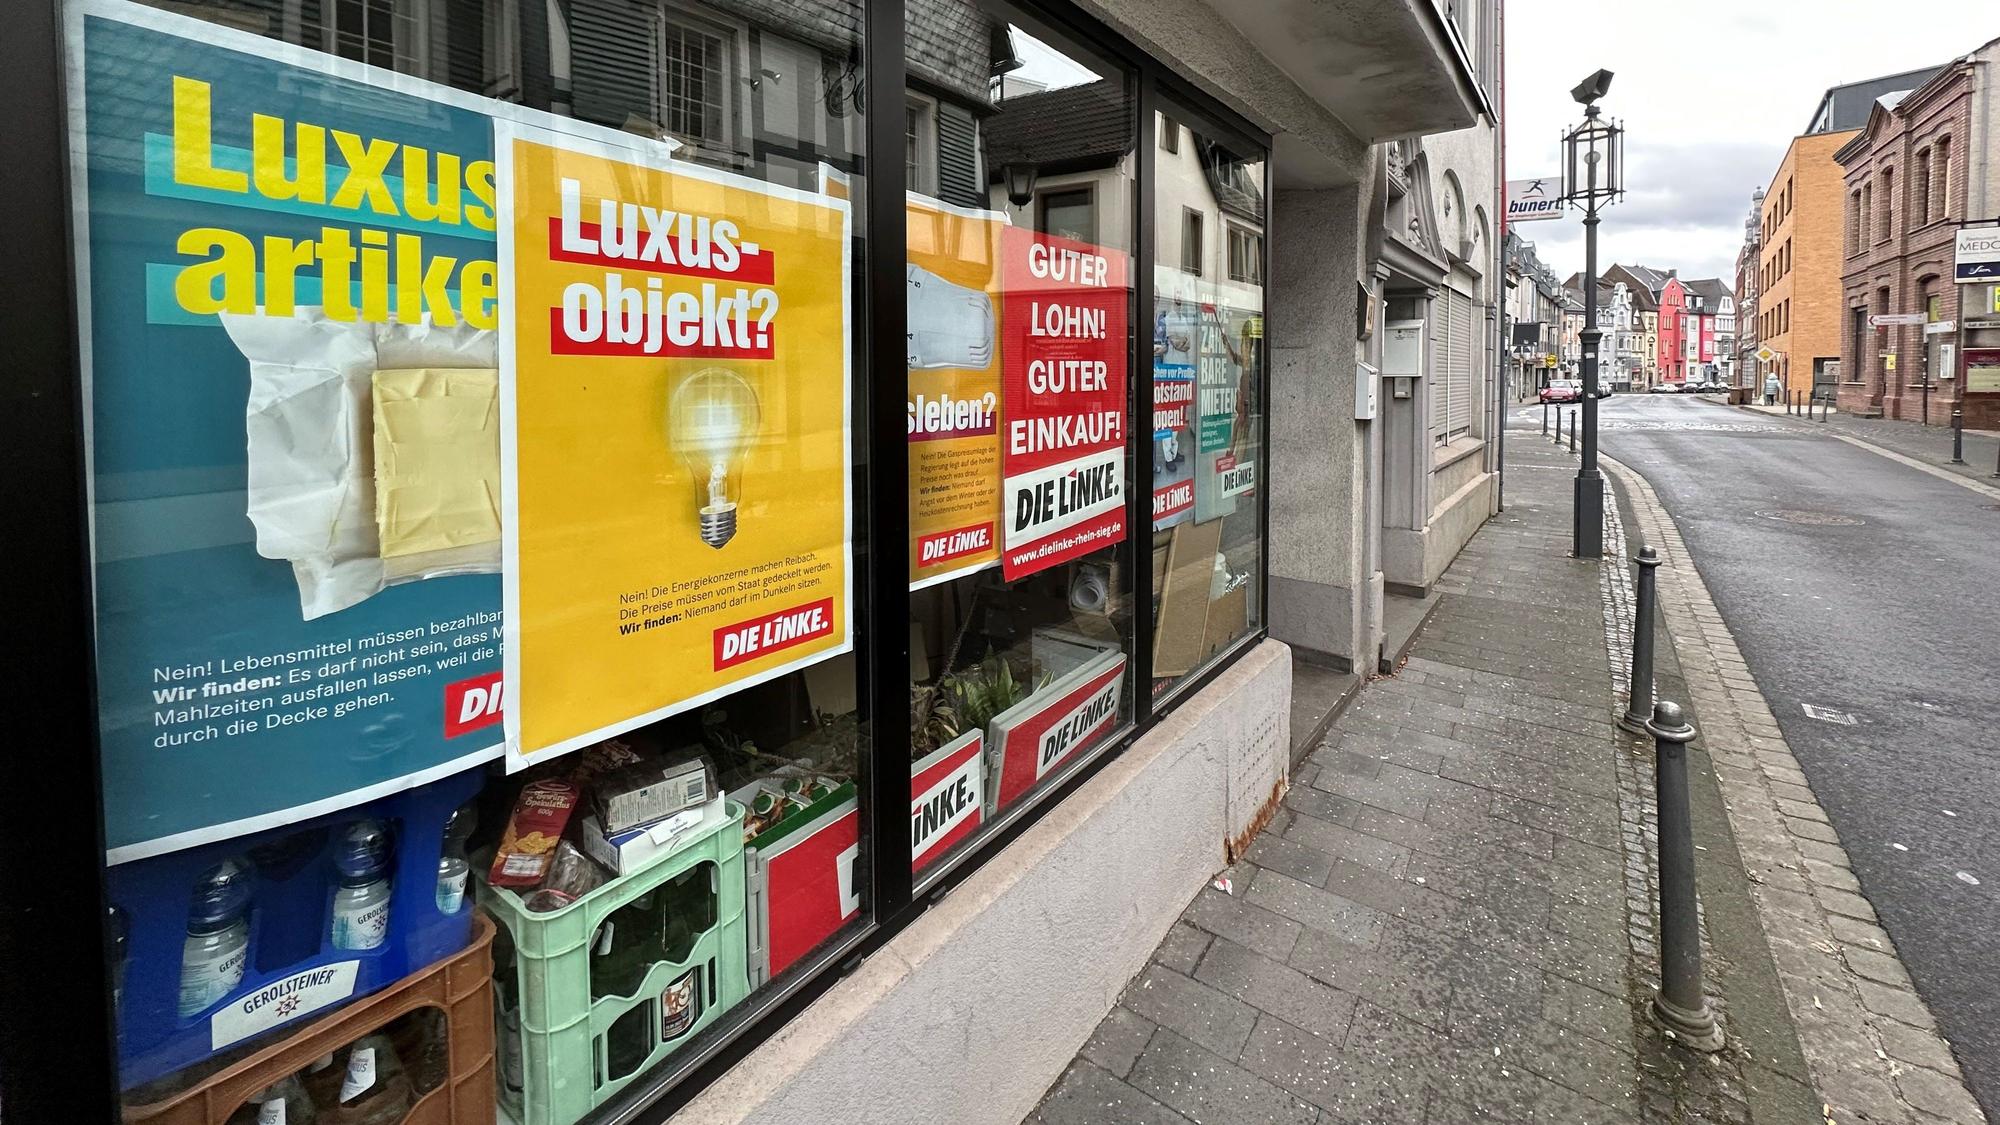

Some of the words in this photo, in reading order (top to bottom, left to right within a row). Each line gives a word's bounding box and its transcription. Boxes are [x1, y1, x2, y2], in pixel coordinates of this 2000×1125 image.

[561, 177, 760, 272] Luxus-
[1509, 200, 1560, 213] bunert
[175, 225, 497, 330] artike
[1029, 243, 1108, 288] GUTER
[562, 272, 780, 354] objekt?
[1031, 302, 1106, 340] LOHN!
[1029, 360, 1108, 395] GUTER
[1201, 358, 1227, 385] BARE
[1011, 411, 1121, 456] EINKAUF!
[920, 487, 930, 495] Wir
[1015, 479, 1055, 532] DIE
[922, 538, 948, 561] DIE
[1013, 522, 1121, 566] www.dielinke-rhein-sieg.de
[620, 589, 649, 604] Nein!
[651, 585, 669, 598] Die
[671, 567, 749, 593] Energiekonzerne
[751, 560, 783, 574] machen
[785, 552, 817, 566] Reibach.
[620, 608, 638, 620] Die
[641, 600, 673, 616] Preise
[676, 590, 714, 607] müssen
[716, 585, 736, 597] vom
[738, 577, 761, 592] Staat
[763, 568, 801, 587] gedeckelt
[803, 561, 833, 577] werden.
[619, 622, 641, 635] Wir
[643, 612, 682, 629] finden:
[684, 602, 727, 619] Niemand
[729, 596, 747, 608] darf
[749, 592, 761, 602] im
[763, 583, 796, 599] Dunkeln
[797, 577, 822, 590] sitzen.
[154, 662, 213, 683] Nein!
[220, 638, 353, 675] Lebensmittel
[358, 626, 425, 651] müssen
[430, 610, 503, 635] bezahlbar
[722, 626, 761, 660] DIE
[153, 687, 197, 705] Wir
[201, 674, 282, 699] finden:
[289, 669, 311, 684] Es
[318, 658, 356, 678] darf
[362, 649, 406, 669] nicht
[410, 639, 448, 660] sein,
[453, 631, 488, 648] dass
[155, 695, 274, 727] Mahlzeiten
[281, 677, 367, 704] ausfallen
[373, 663, 432, 687] lassen,
[437, 651, 467, 670] weil
[472, 648, 494, 662] die
[154, 725, 219, 748] durch
[227, 718, 258, 736] die
[266, 706, 328, 729] Decke
[334, 691, 395, 717] gehen.
[459, 681, 504, 724] DI
[1043, 725, 1071, 767] DIE
[243, 966, 335, 1014] GEROLSTEINER
